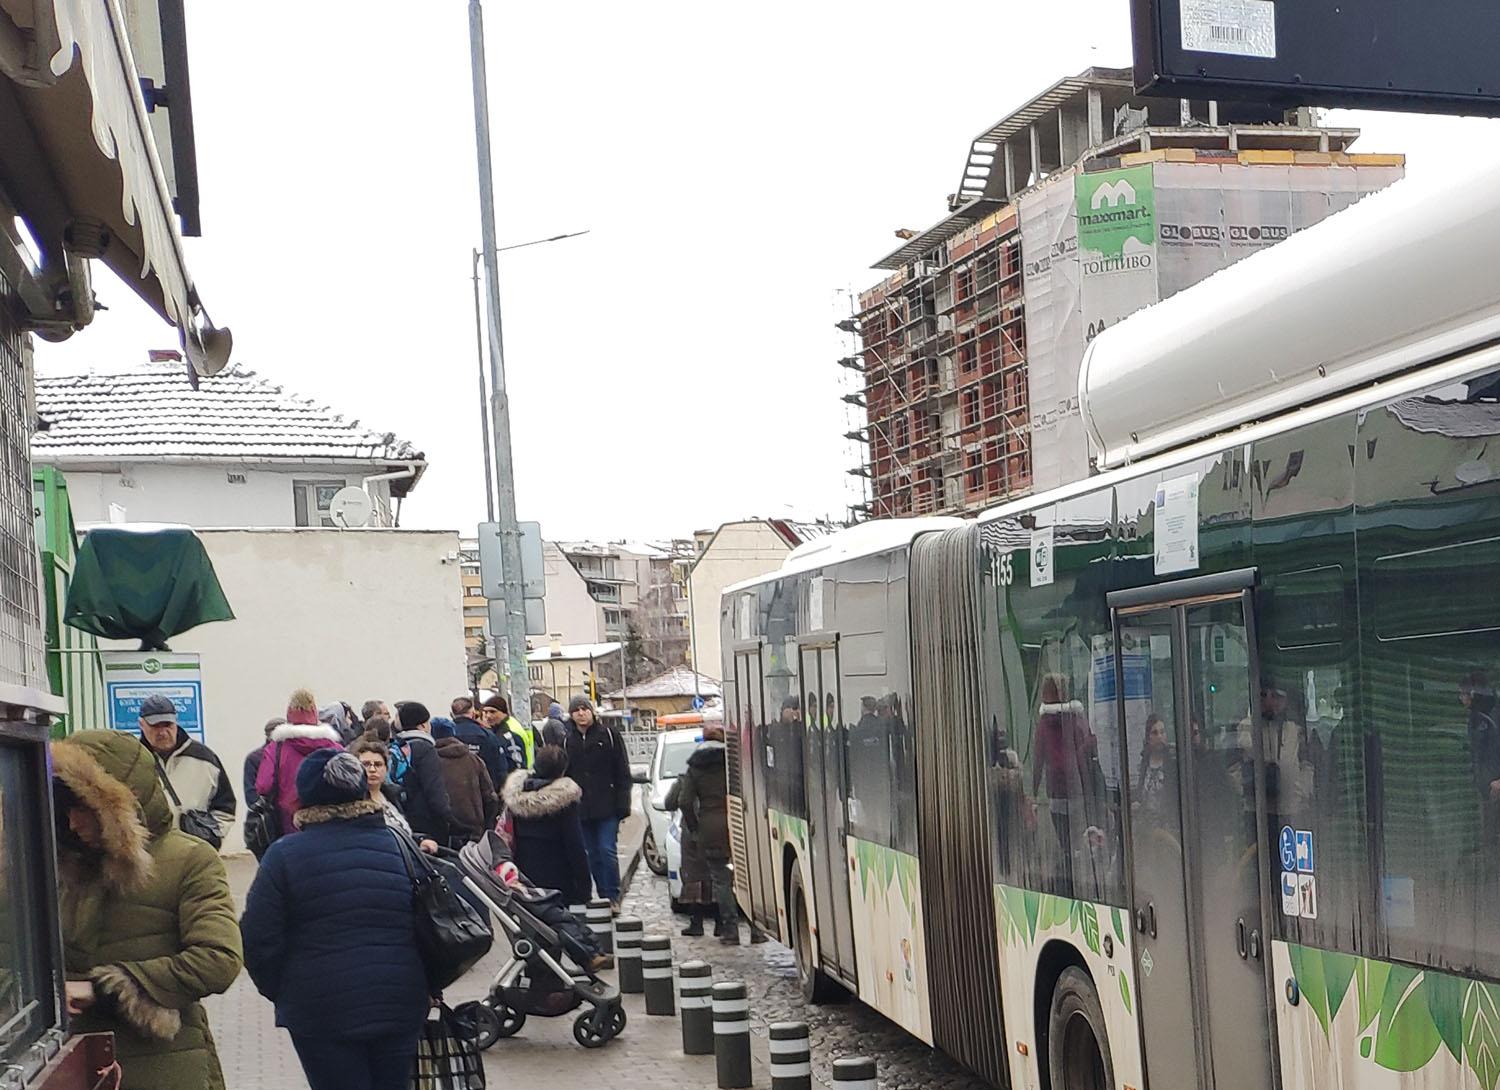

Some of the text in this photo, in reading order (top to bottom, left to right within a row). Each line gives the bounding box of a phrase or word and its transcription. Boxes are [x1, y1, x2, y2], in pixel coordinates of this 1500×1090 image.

[1160, 224, 1220, 240] GLOBUS
[1229, 226, 1288, 240] GLOBUS
[991, 552, 1012, 587] 1155
